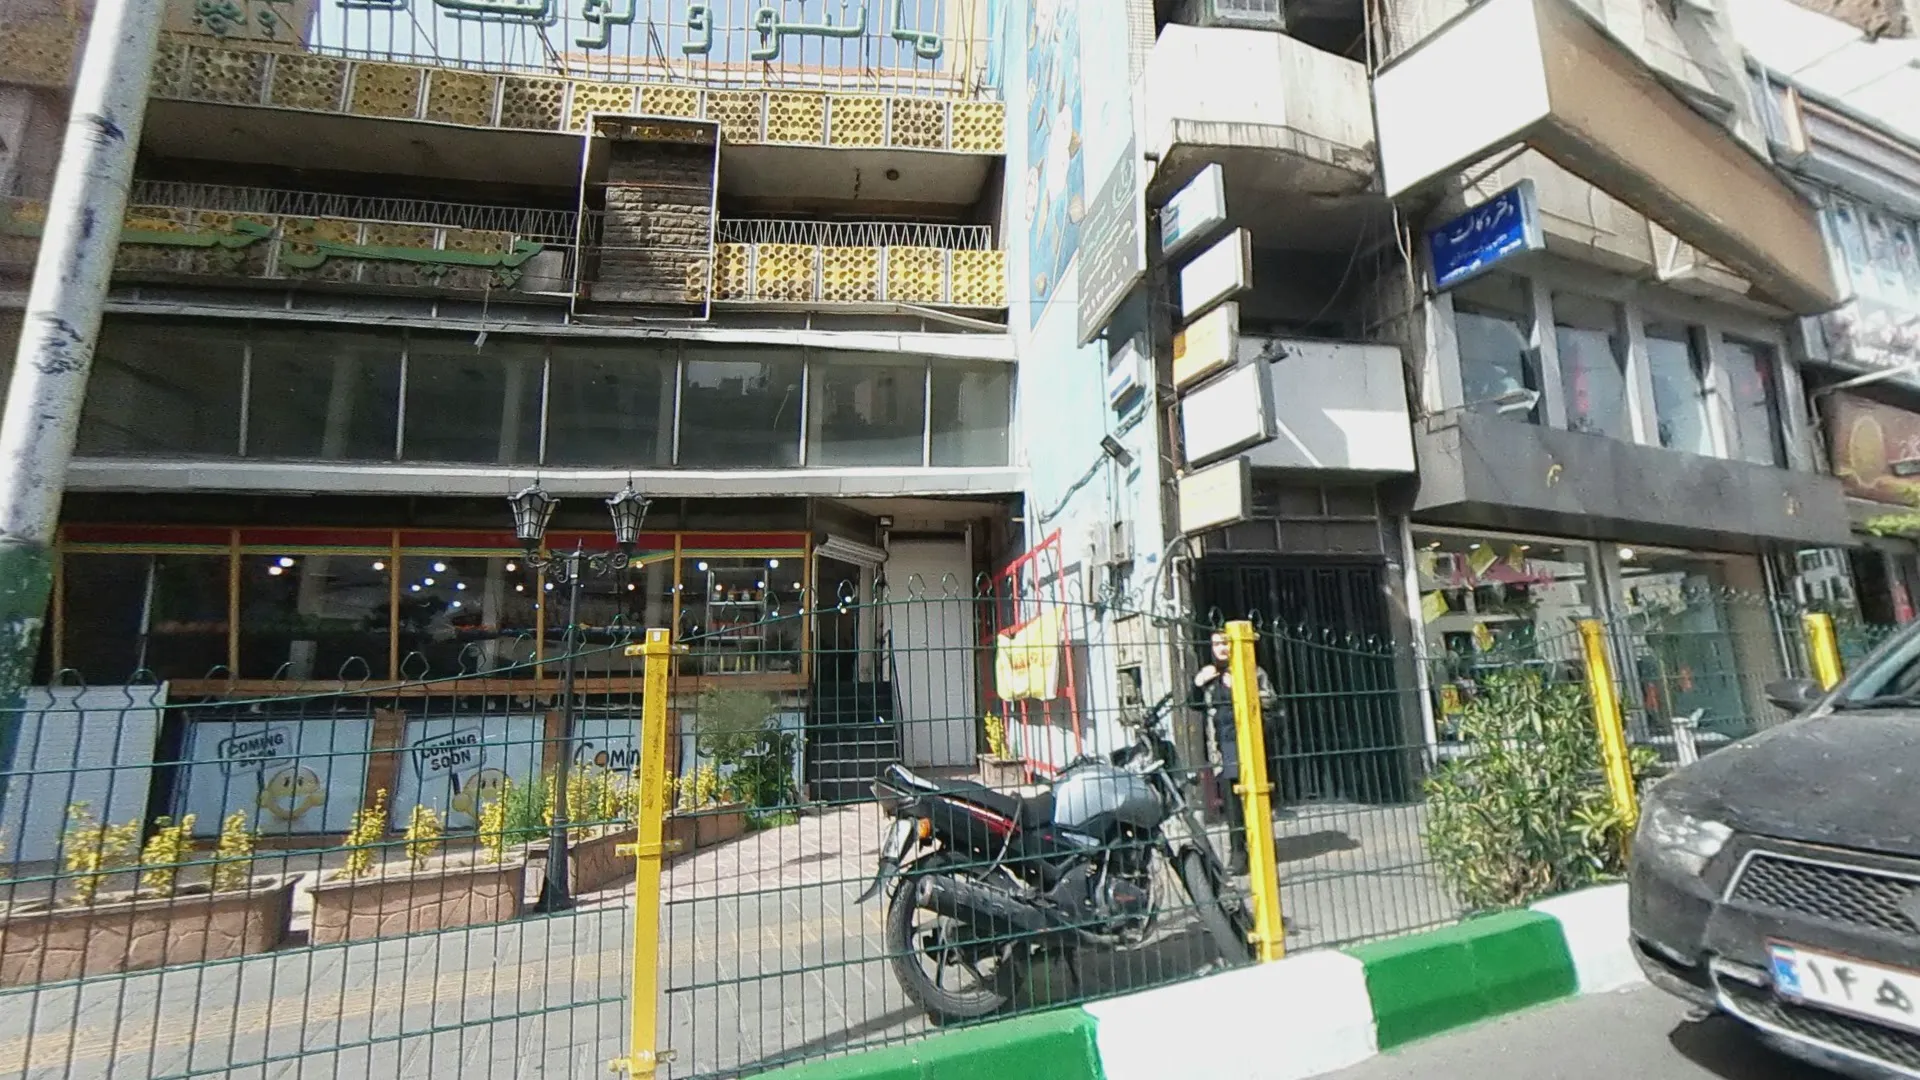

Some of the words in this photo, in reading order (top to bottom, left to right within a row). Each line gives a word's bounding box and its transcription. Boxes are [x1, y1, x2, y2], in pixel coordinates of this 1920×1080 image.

[227, 733, 284, 758] COMING
[421, 734, 478, 759] COMING
[430, 750, 472, 771] SOON
